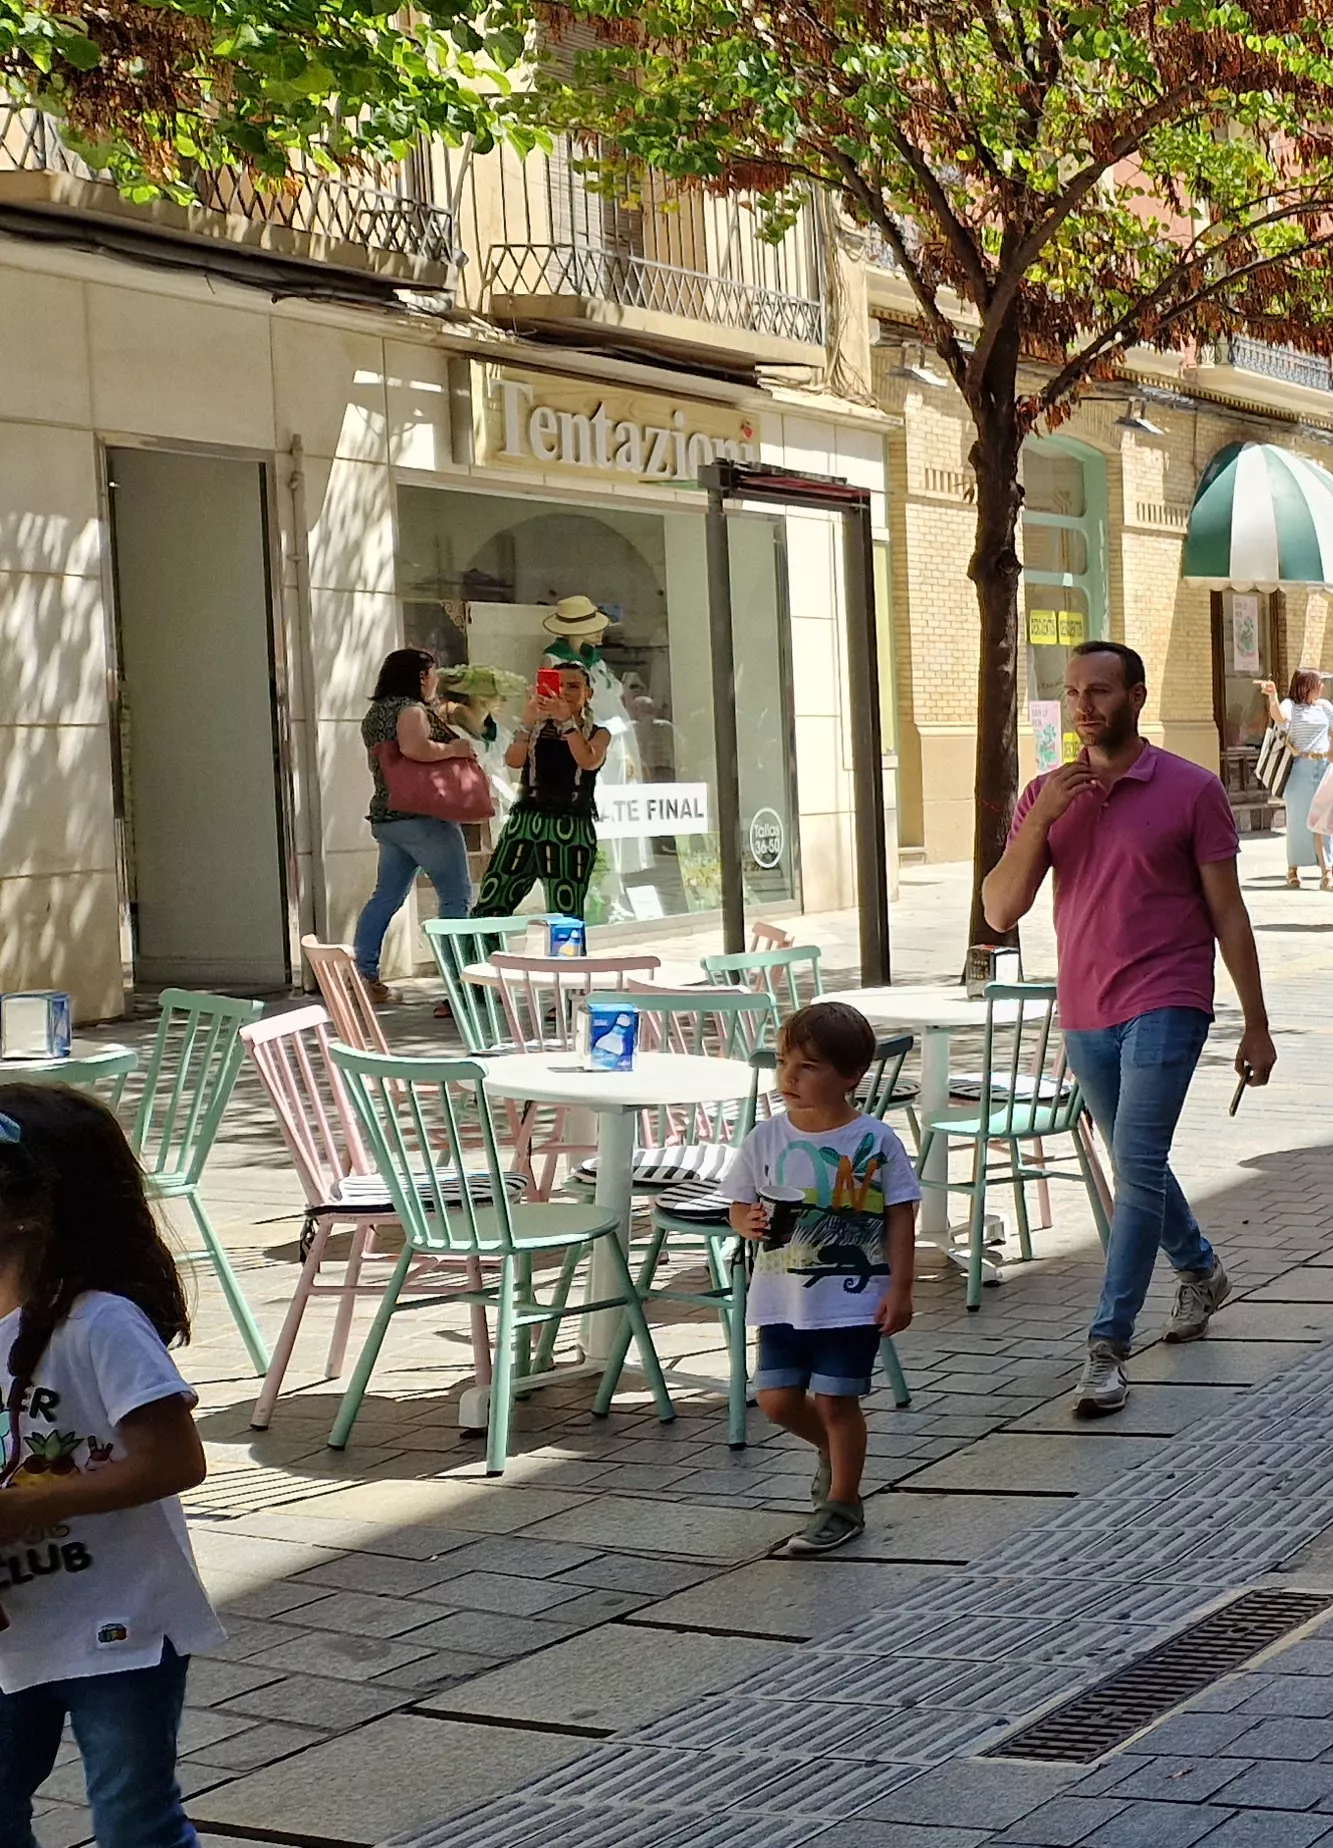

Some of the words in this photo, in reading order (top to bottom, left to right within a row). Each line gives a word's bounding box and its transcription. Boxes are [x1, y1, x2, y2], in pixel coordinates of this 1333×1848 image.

[647, 797, 705, 821] FINAL
[753, 823, 780, 838] Tallas
[754, 838, 780, 856] 36-50
